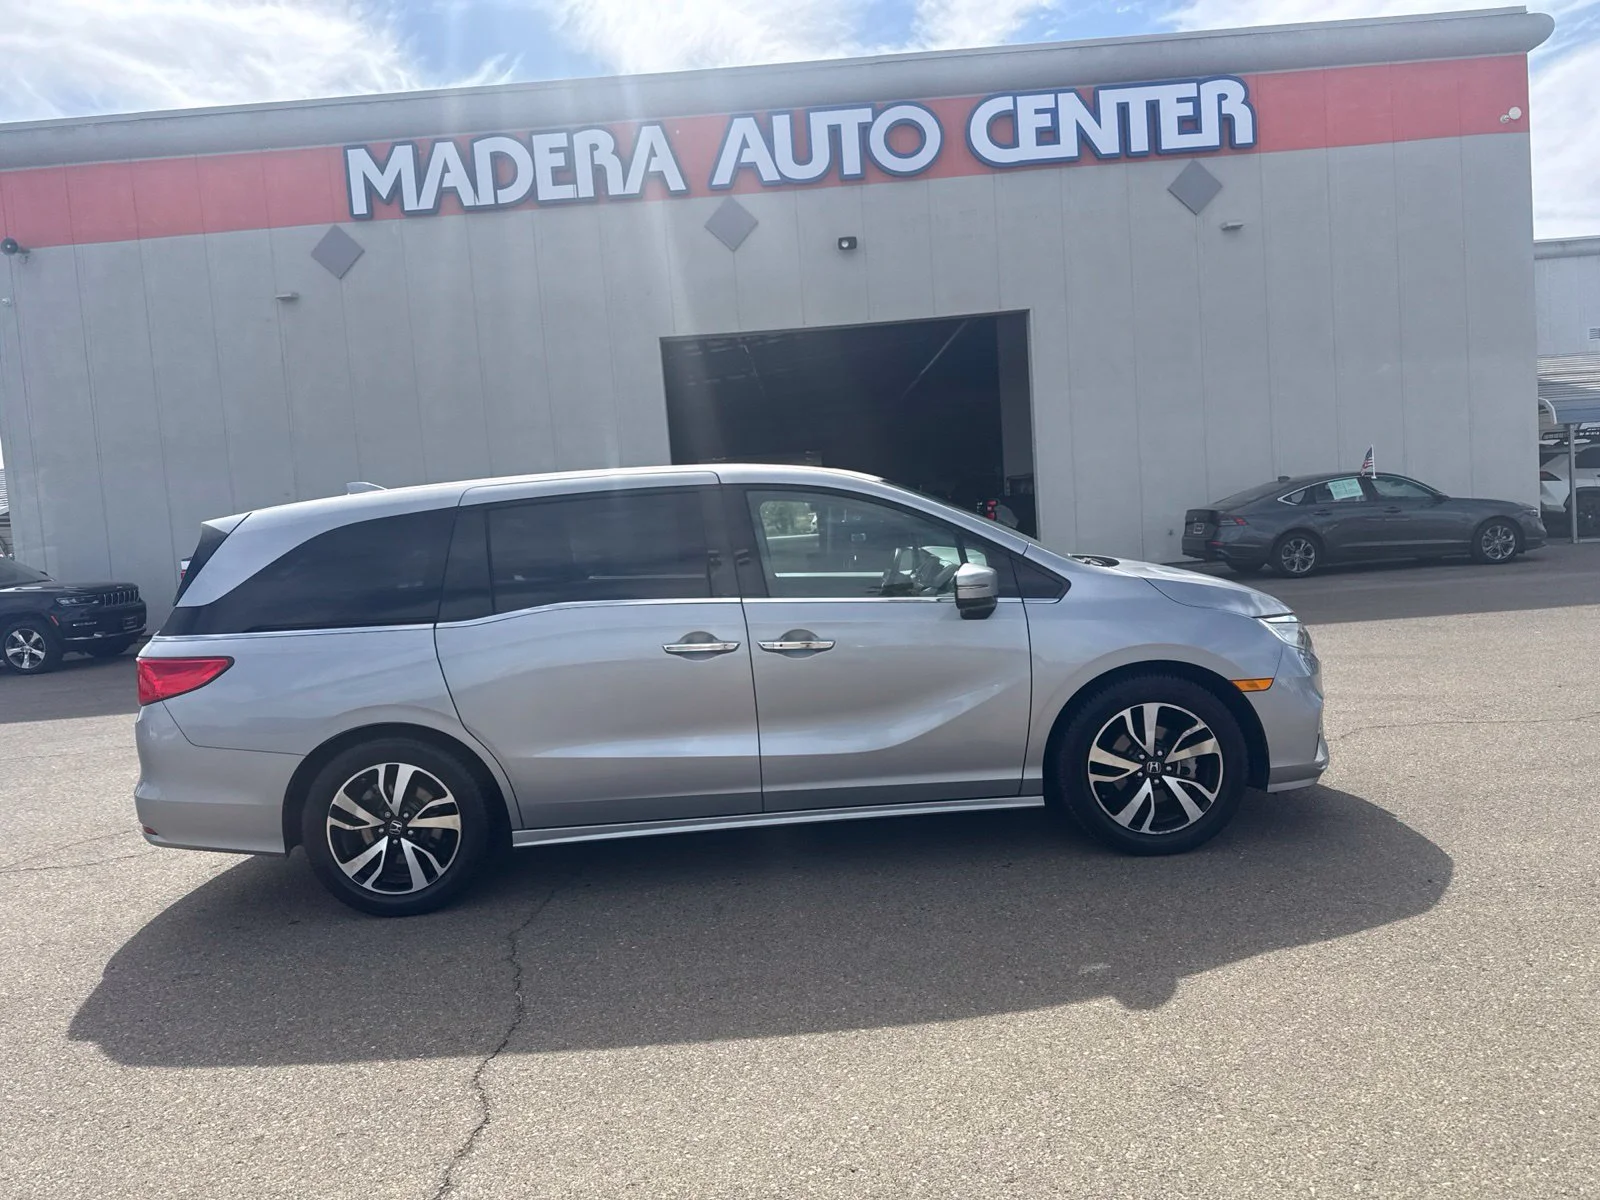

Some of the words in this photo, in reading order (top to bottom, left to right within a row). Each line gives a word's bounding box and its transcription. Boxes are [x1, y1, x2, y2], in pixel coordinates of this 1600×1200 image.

[345, 123, 688, 216] MADERA
[711, 104, 941, 187] AUTO
[968, 77, 1255, 164] CENTER
